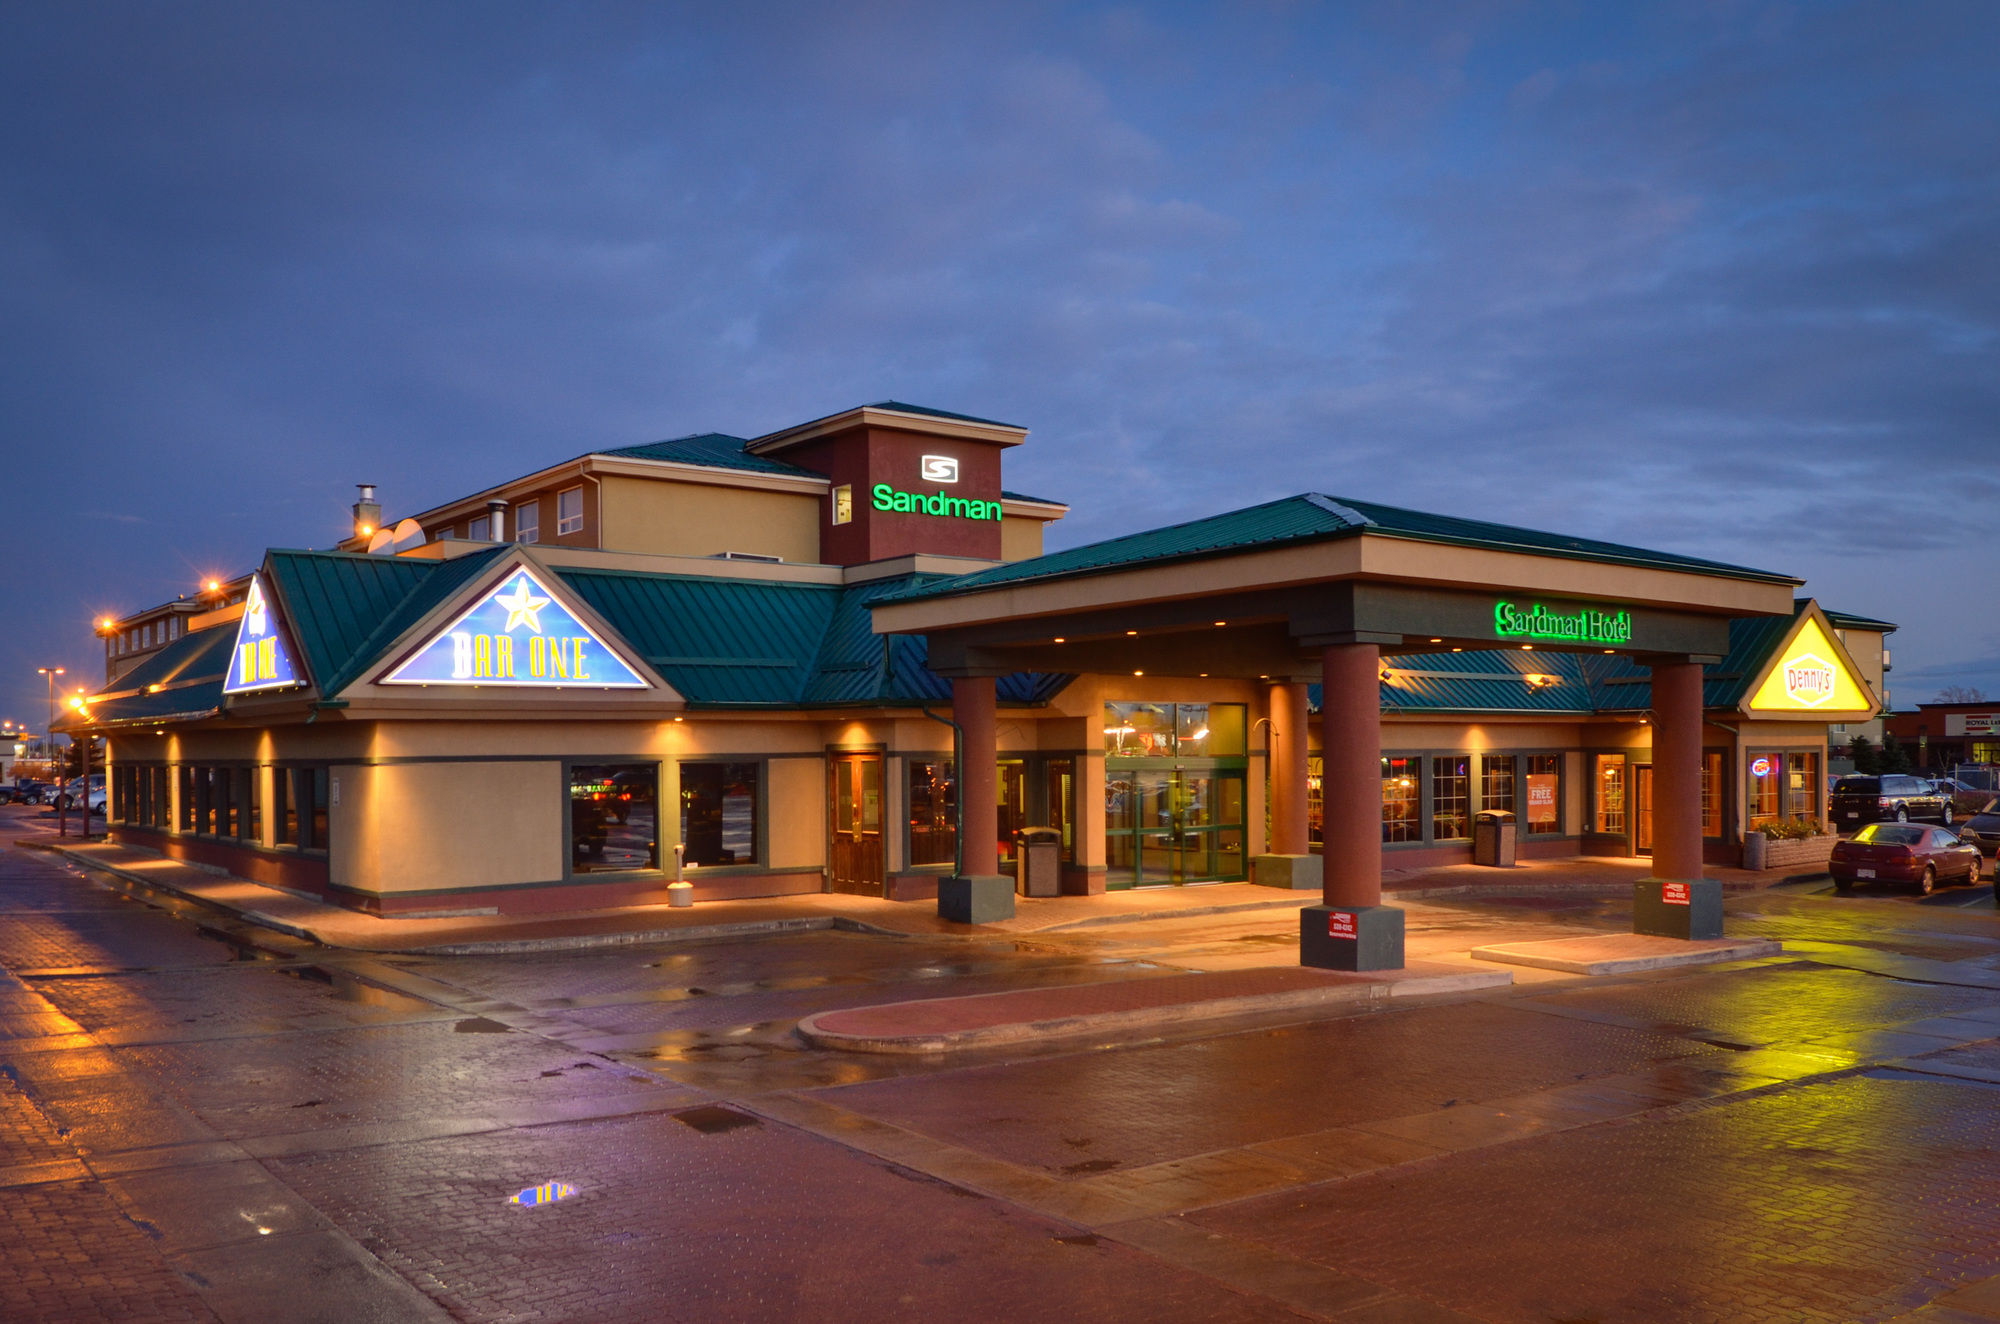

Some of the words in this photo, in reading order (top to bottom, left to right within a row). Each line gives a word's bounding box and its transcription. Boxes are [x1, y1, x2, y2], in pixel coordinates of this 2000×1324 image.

[872, 483, 1002, 521] Sandman
[1500, 602, 1586, 637] Sandman
[1588, 610, 1632, 641] Hotel
[451, 631, 516, 679] BAR
[529, 636, 590, 680] ONE
[1788, 667, 1830, 693] Denny's
[1531, 788, 1552, 799] FREE
